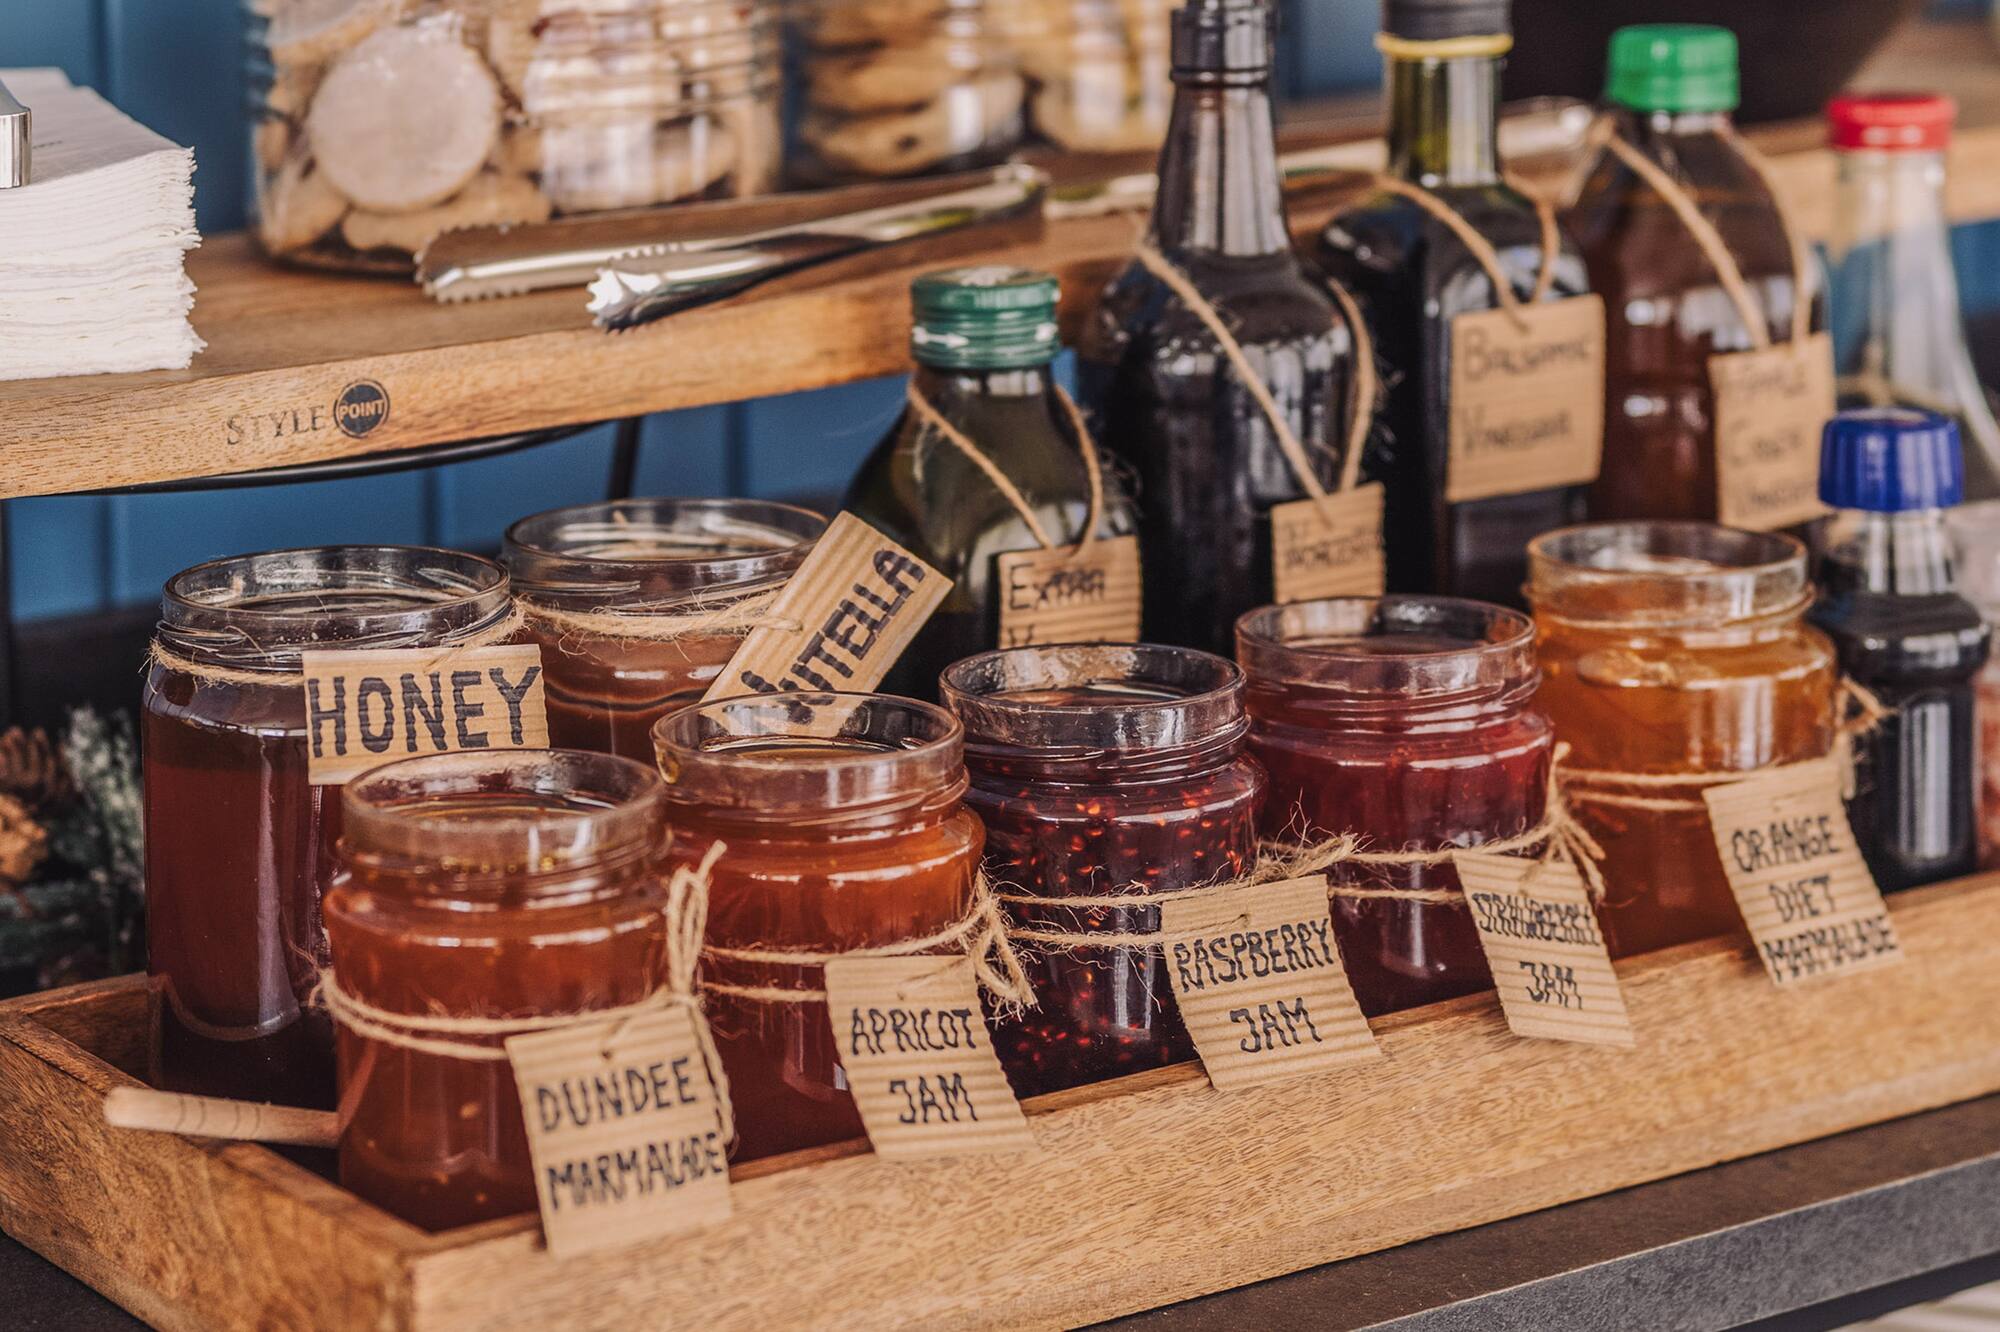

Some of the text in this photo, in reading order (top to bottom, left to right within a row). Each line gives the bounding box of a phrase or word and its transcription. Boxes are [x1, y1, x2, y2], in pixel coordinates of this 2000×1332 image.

[226, 400, 385, 445] STYLE POINT
[307, 665, 542, 758] HONEY
[1732, 815, 1840, 873] ORANGE
[1768, 874, 1837, 923] DIET
[1172, 917, 1335, 994] RASPBERRY
[1519, 960, 1584, 1010] JAM
[850, 1007, 977, 1056] APRICOT
[1229, 997, 1323, 1054] JAM
[536, 1056, 697, 1133] DUNDEE
[888, 1072, 979, 1124] JAM
[546, 1131, 725, 1210] MARMALADE
